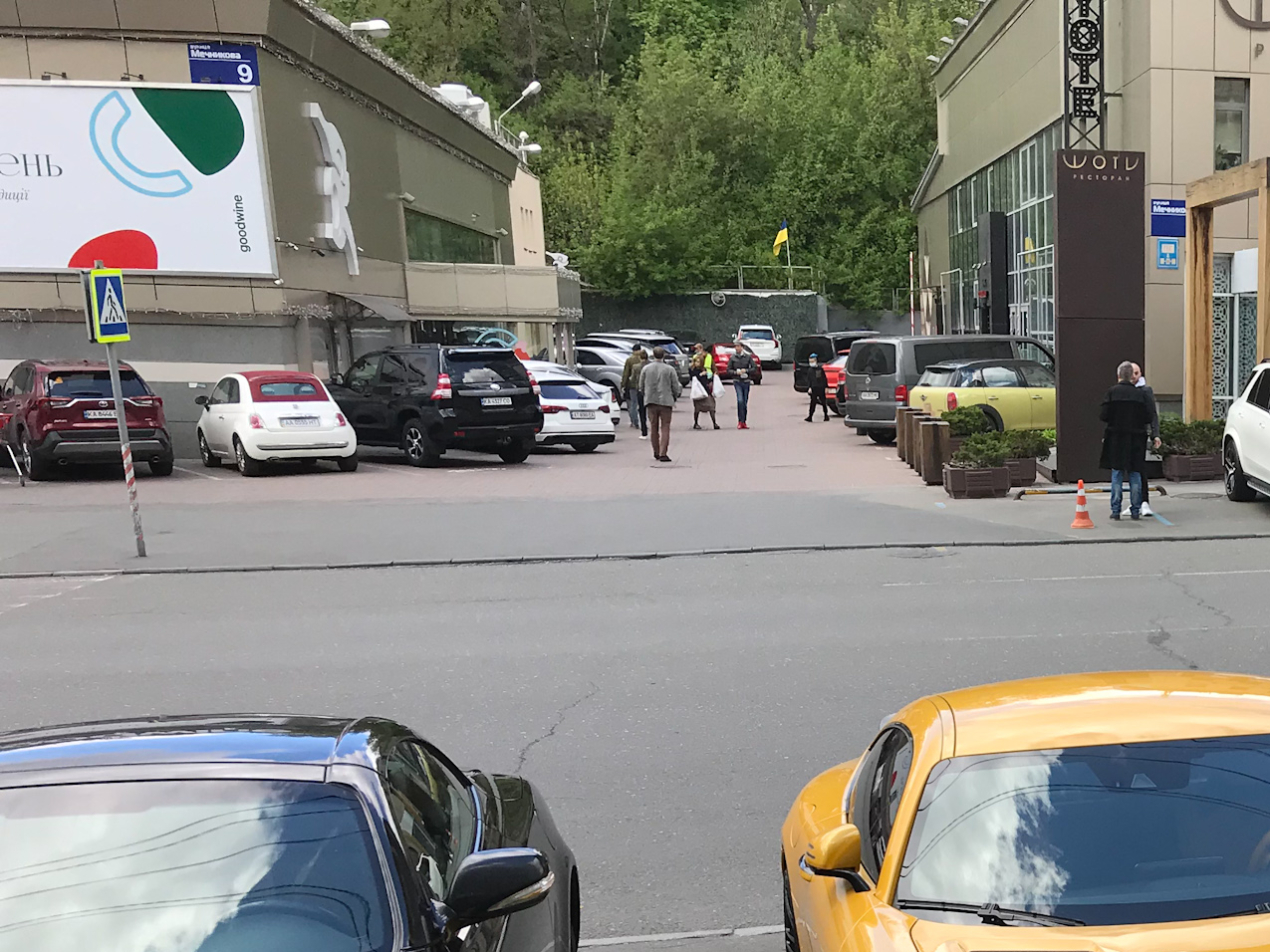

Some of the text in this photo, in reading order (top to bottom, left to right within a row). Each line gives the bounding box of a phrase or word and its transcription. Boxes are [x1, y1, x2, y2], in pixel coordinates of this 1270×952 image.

[190, 49, 242, 59] Мечникова
[236, 63, 254, 84] 9
[232, 194, 251, 253] goodwine
